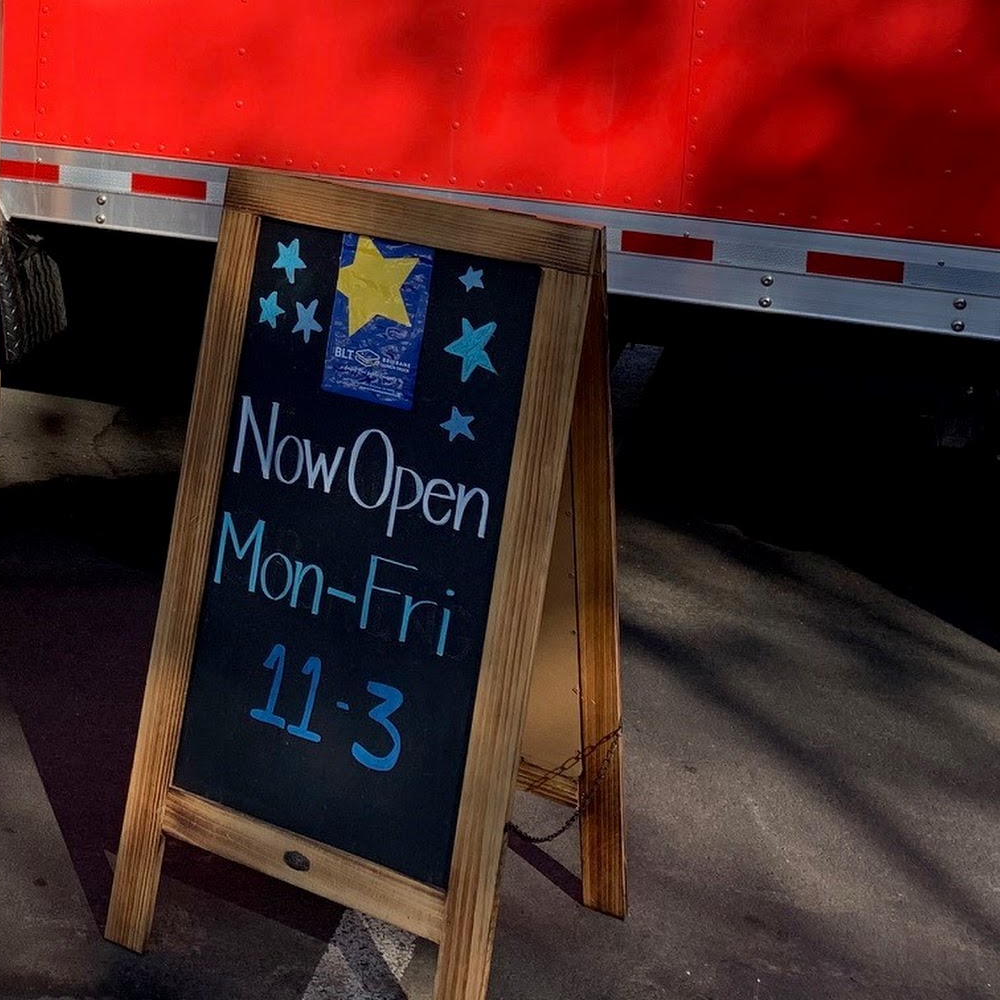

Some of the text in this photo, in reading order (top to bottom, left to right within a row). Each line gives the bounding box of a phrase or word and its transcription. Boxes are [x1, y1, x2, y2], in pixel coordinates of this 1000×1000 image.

[334, 346, 355, 360] BLT
[232, 395, 490, 539] Now Open
[213, 511, 455, 657] Mon-Fri
